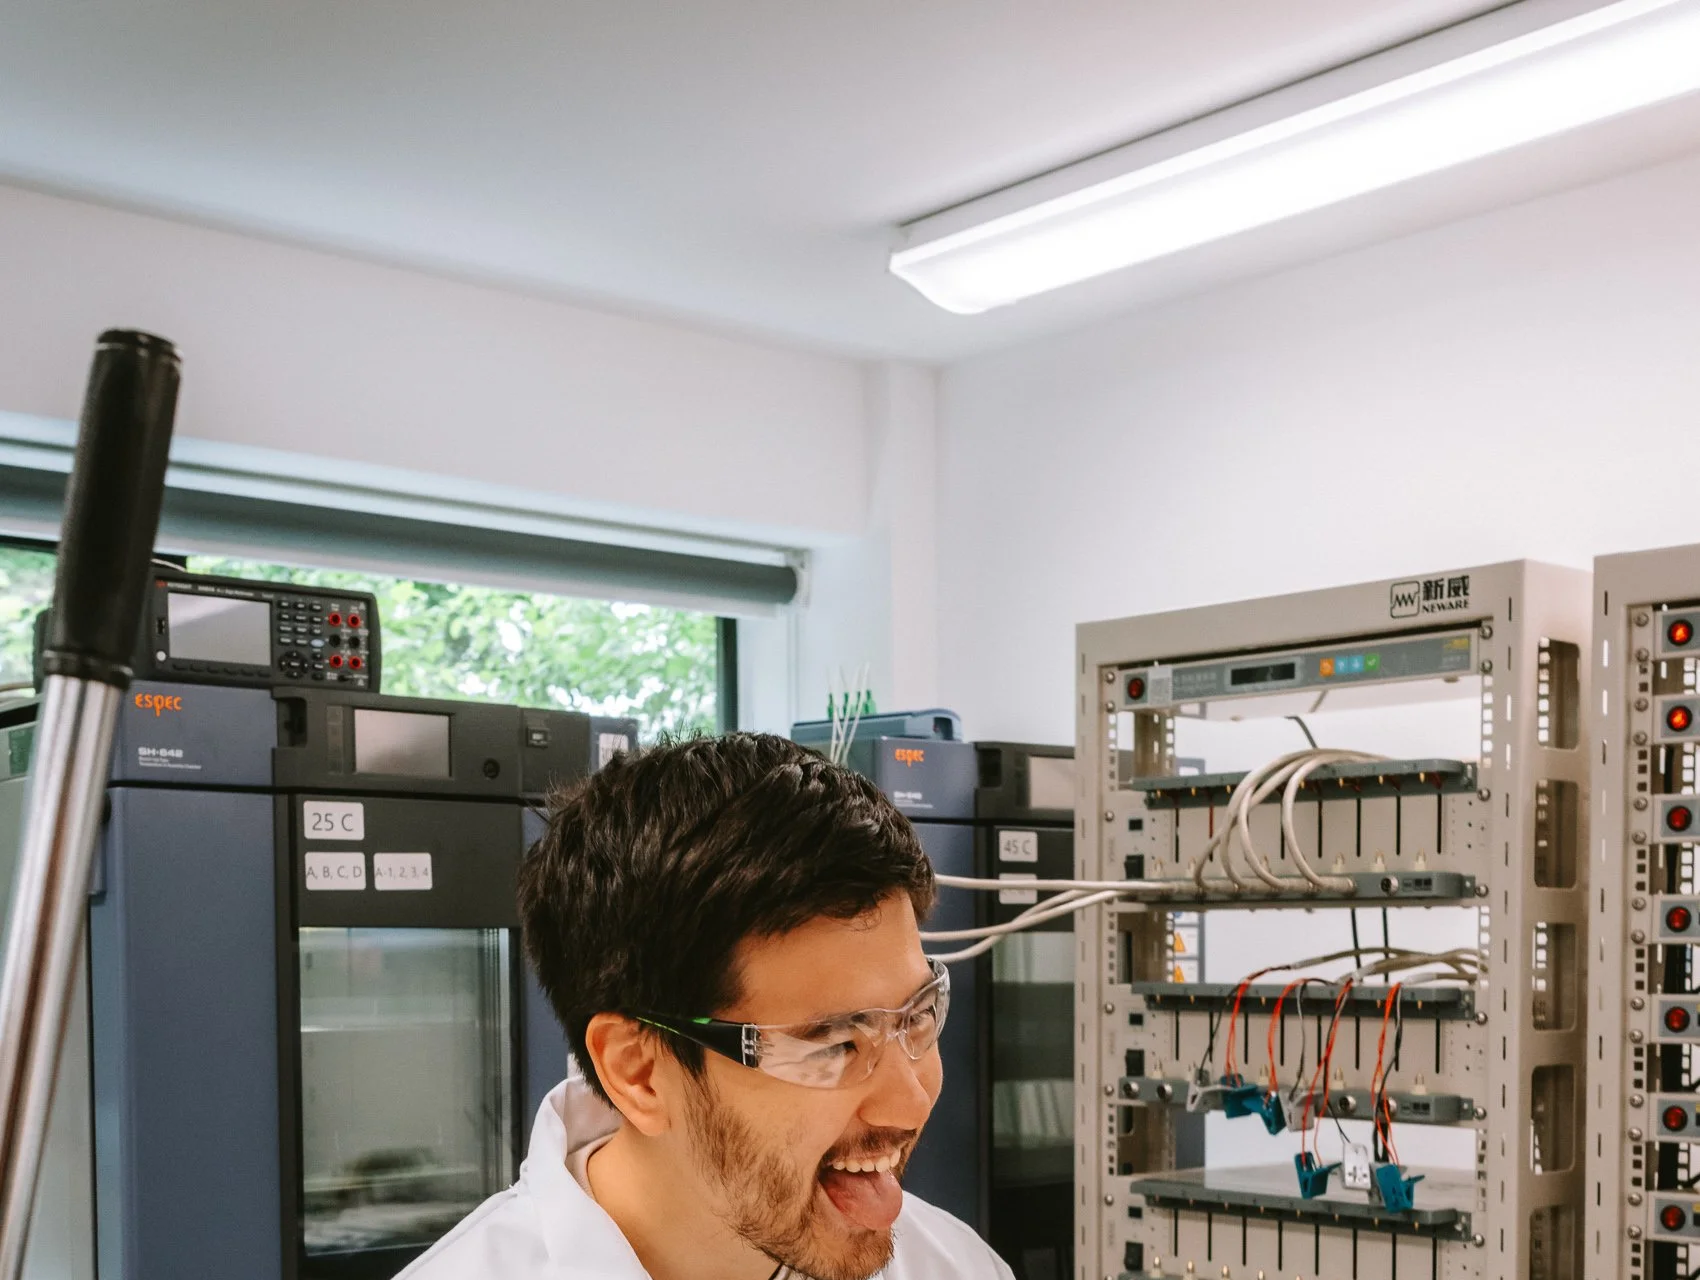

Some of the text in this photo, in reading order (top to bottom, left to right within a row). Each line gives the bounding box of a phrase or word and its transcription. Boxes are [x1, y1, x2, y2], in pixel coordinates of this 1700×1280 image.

[1423, 575, 1469, 600] 新威
[1422, 600, 1468, 612] NEWARE
[312, 812, 353, 831] 25 C
[1004, 839, 1031, 855] 45 C
[353, 866, 363, 878] D
